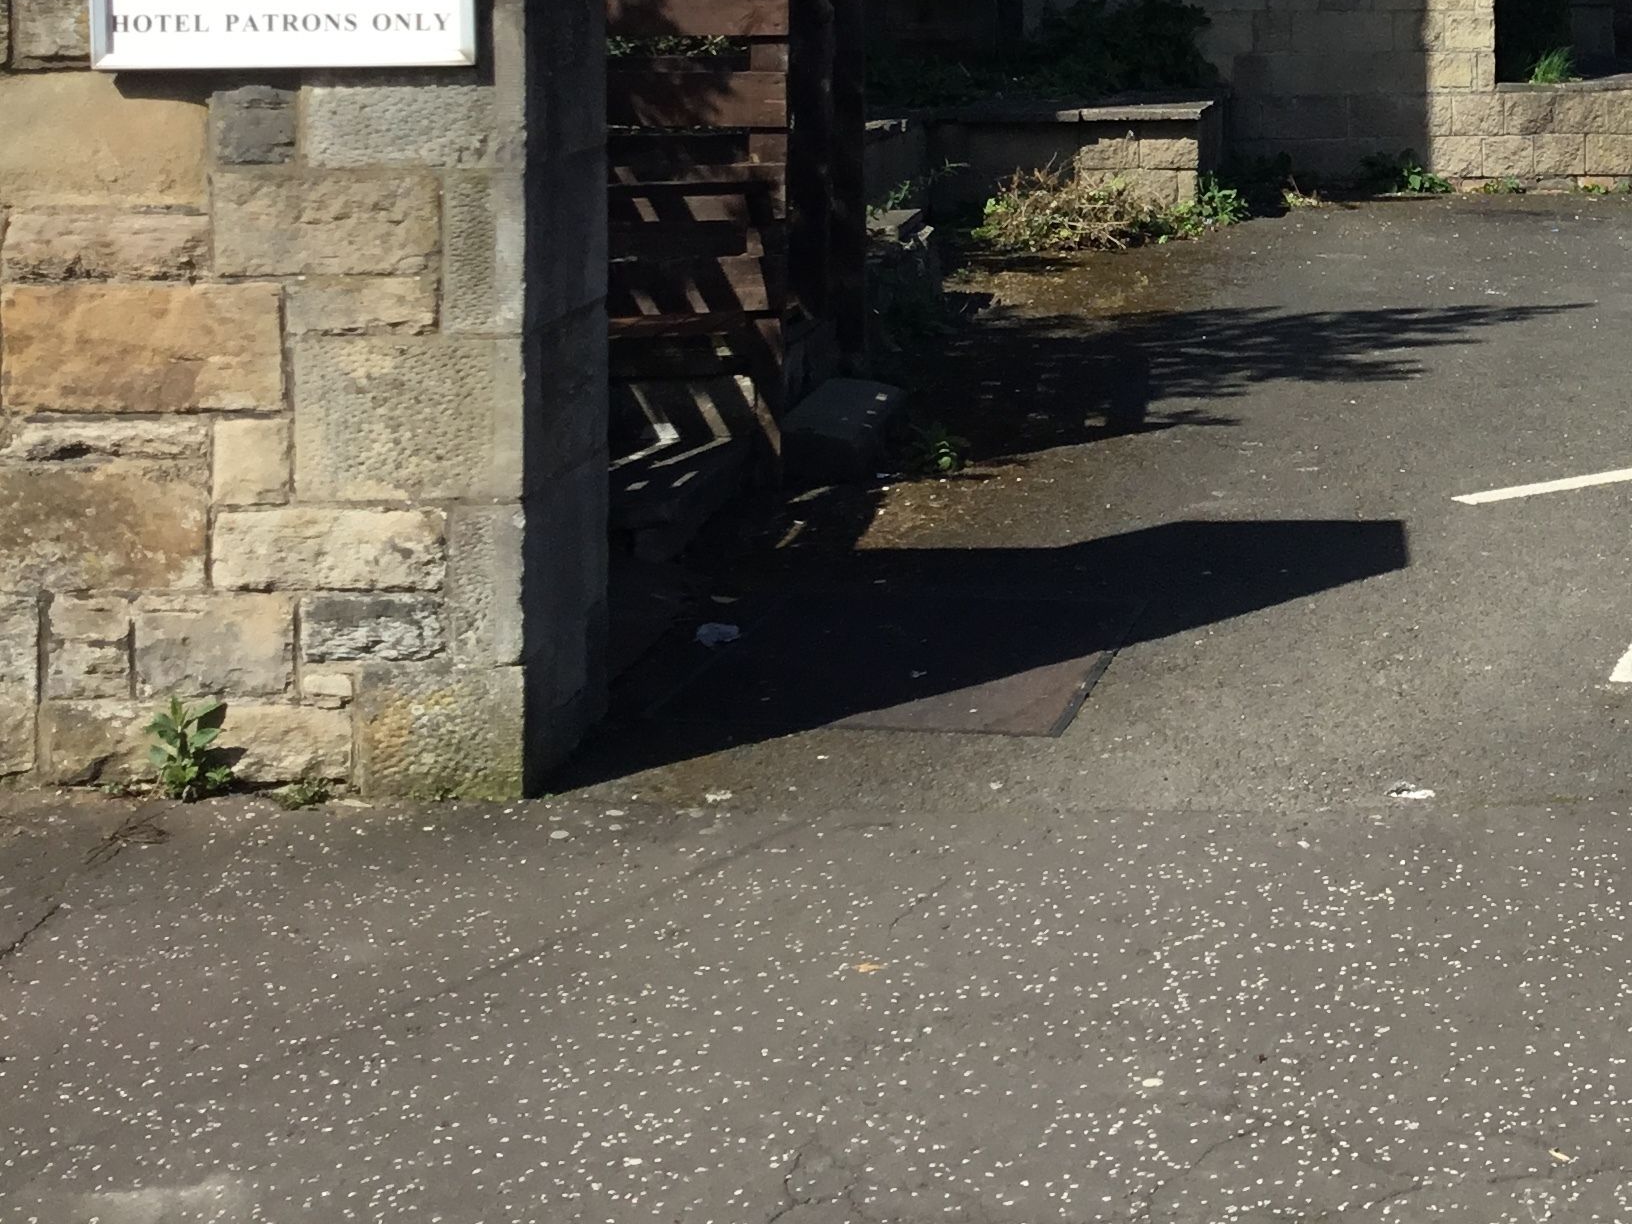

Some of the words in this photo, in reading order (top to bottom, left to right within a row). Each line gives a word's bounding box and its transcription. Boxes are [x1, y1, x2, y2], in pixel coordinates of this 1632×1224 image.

[112, 14, 210, 33] HOTEL
[225, 13, 358, 33] PATRONS
[372, 12, 452, 32] ONLY
